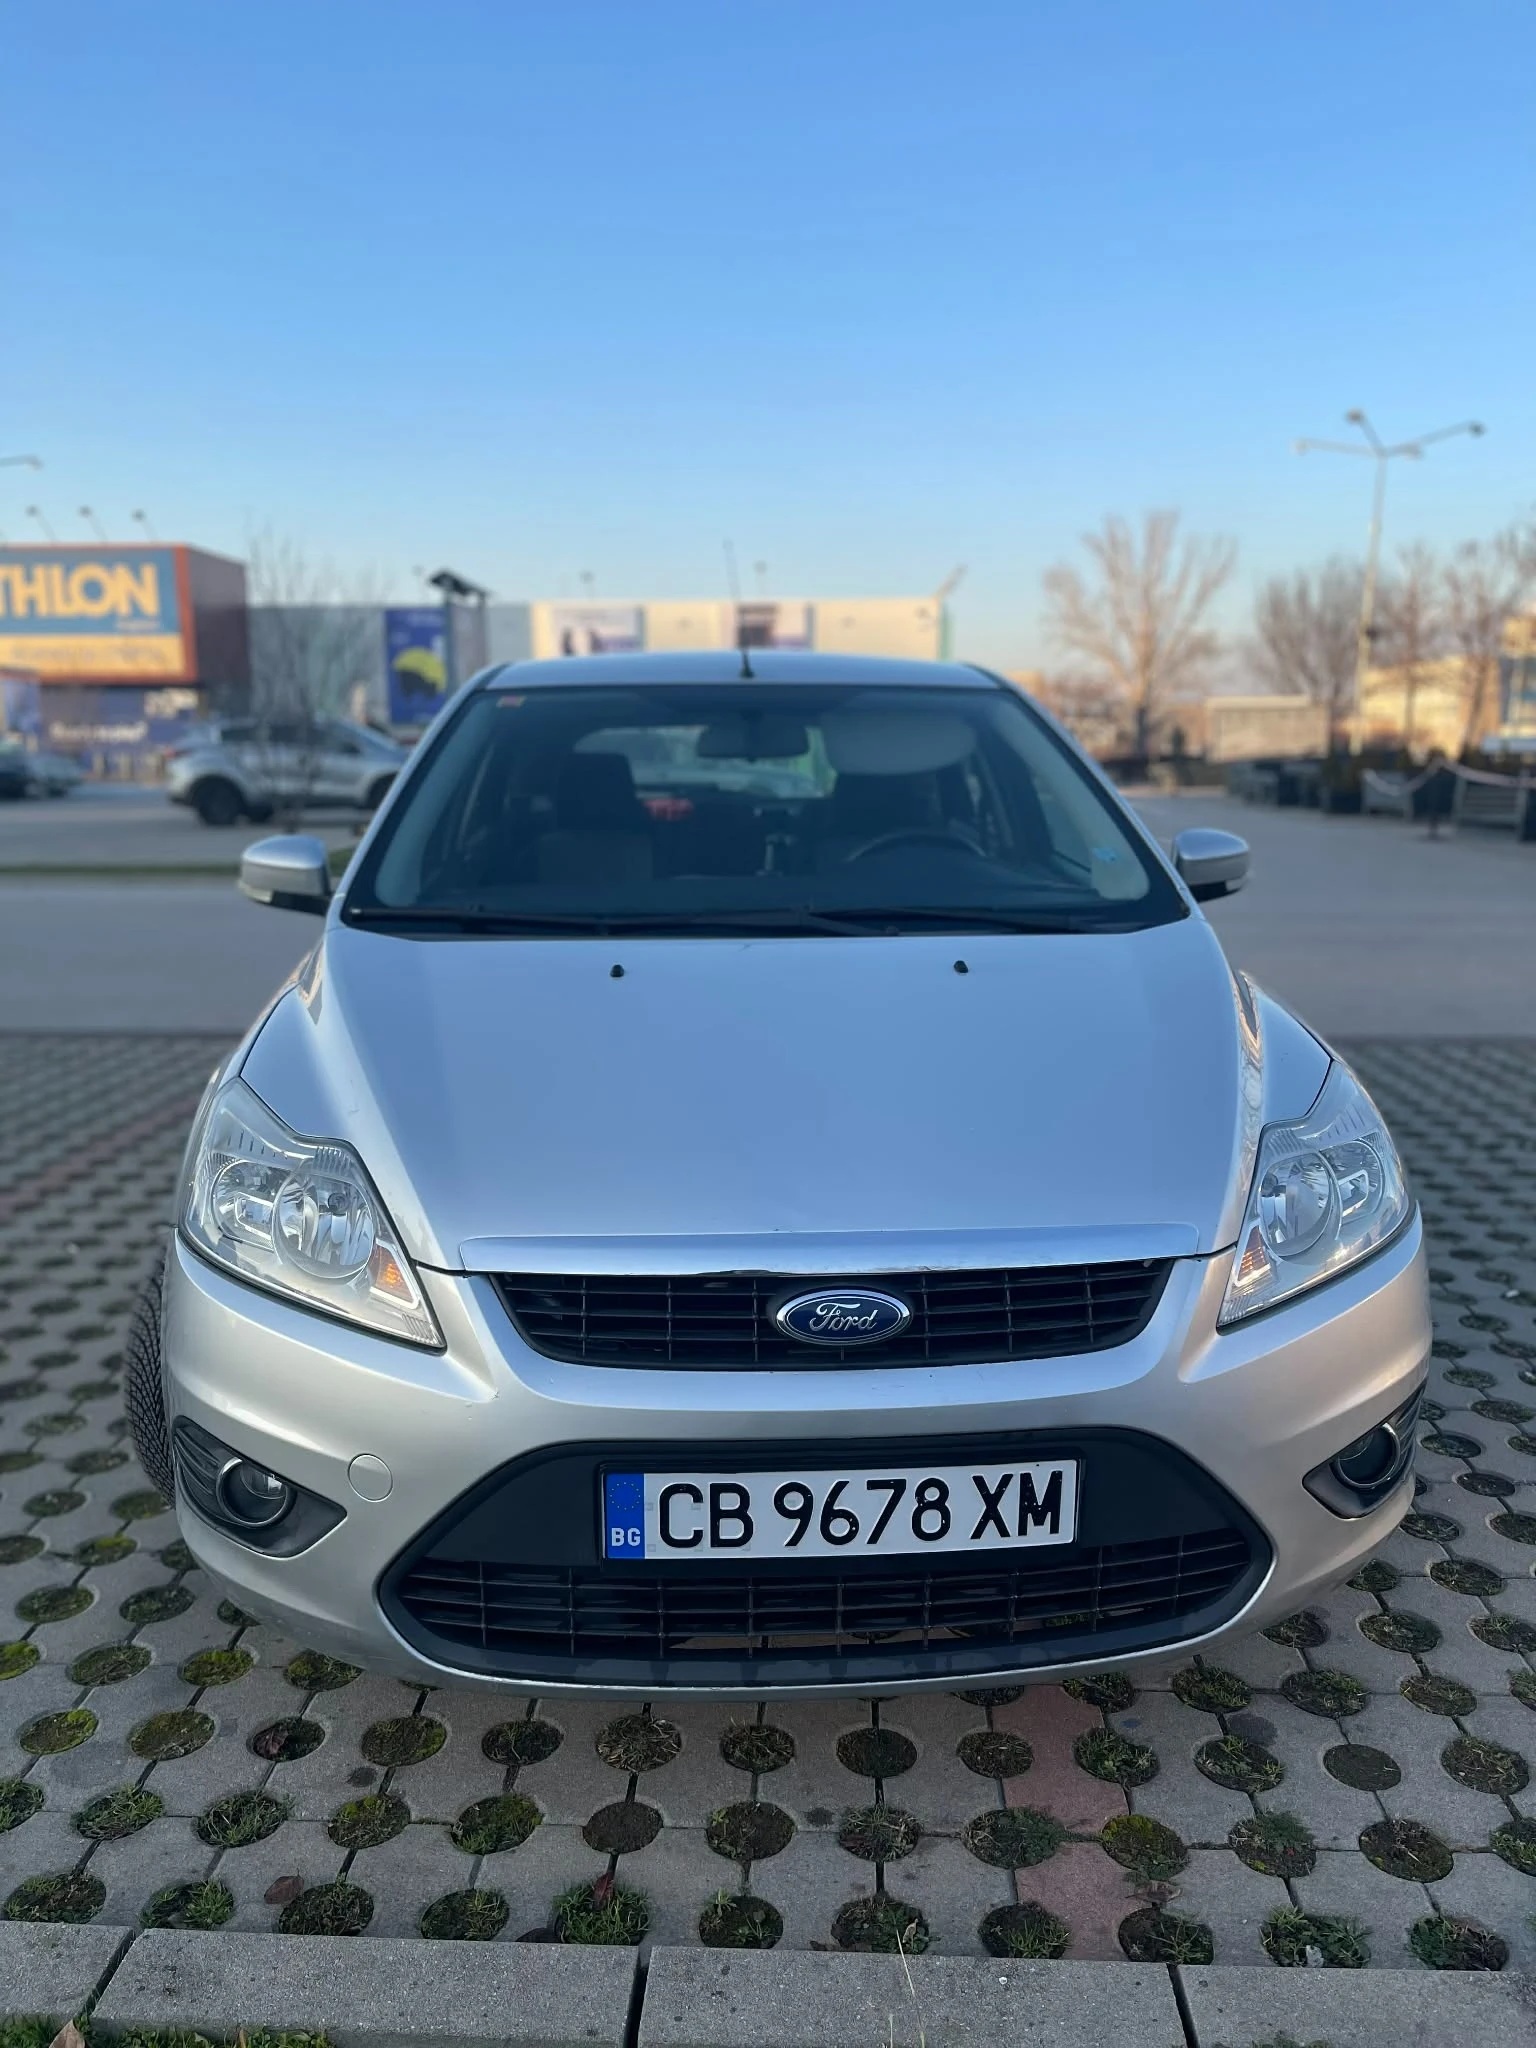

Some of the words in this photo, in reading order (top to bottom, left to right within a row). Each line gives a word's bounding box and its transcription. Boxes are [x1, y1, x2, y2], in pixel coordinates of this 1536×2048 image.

[809, 1302, 878, 1331] Ford
[659, 1482, 754, 1549] CB
[773, 1477, 951, 1547] 9678
[970, 1470, 1063, 1540] XM
[611, 1527, 641, 1547] BG
